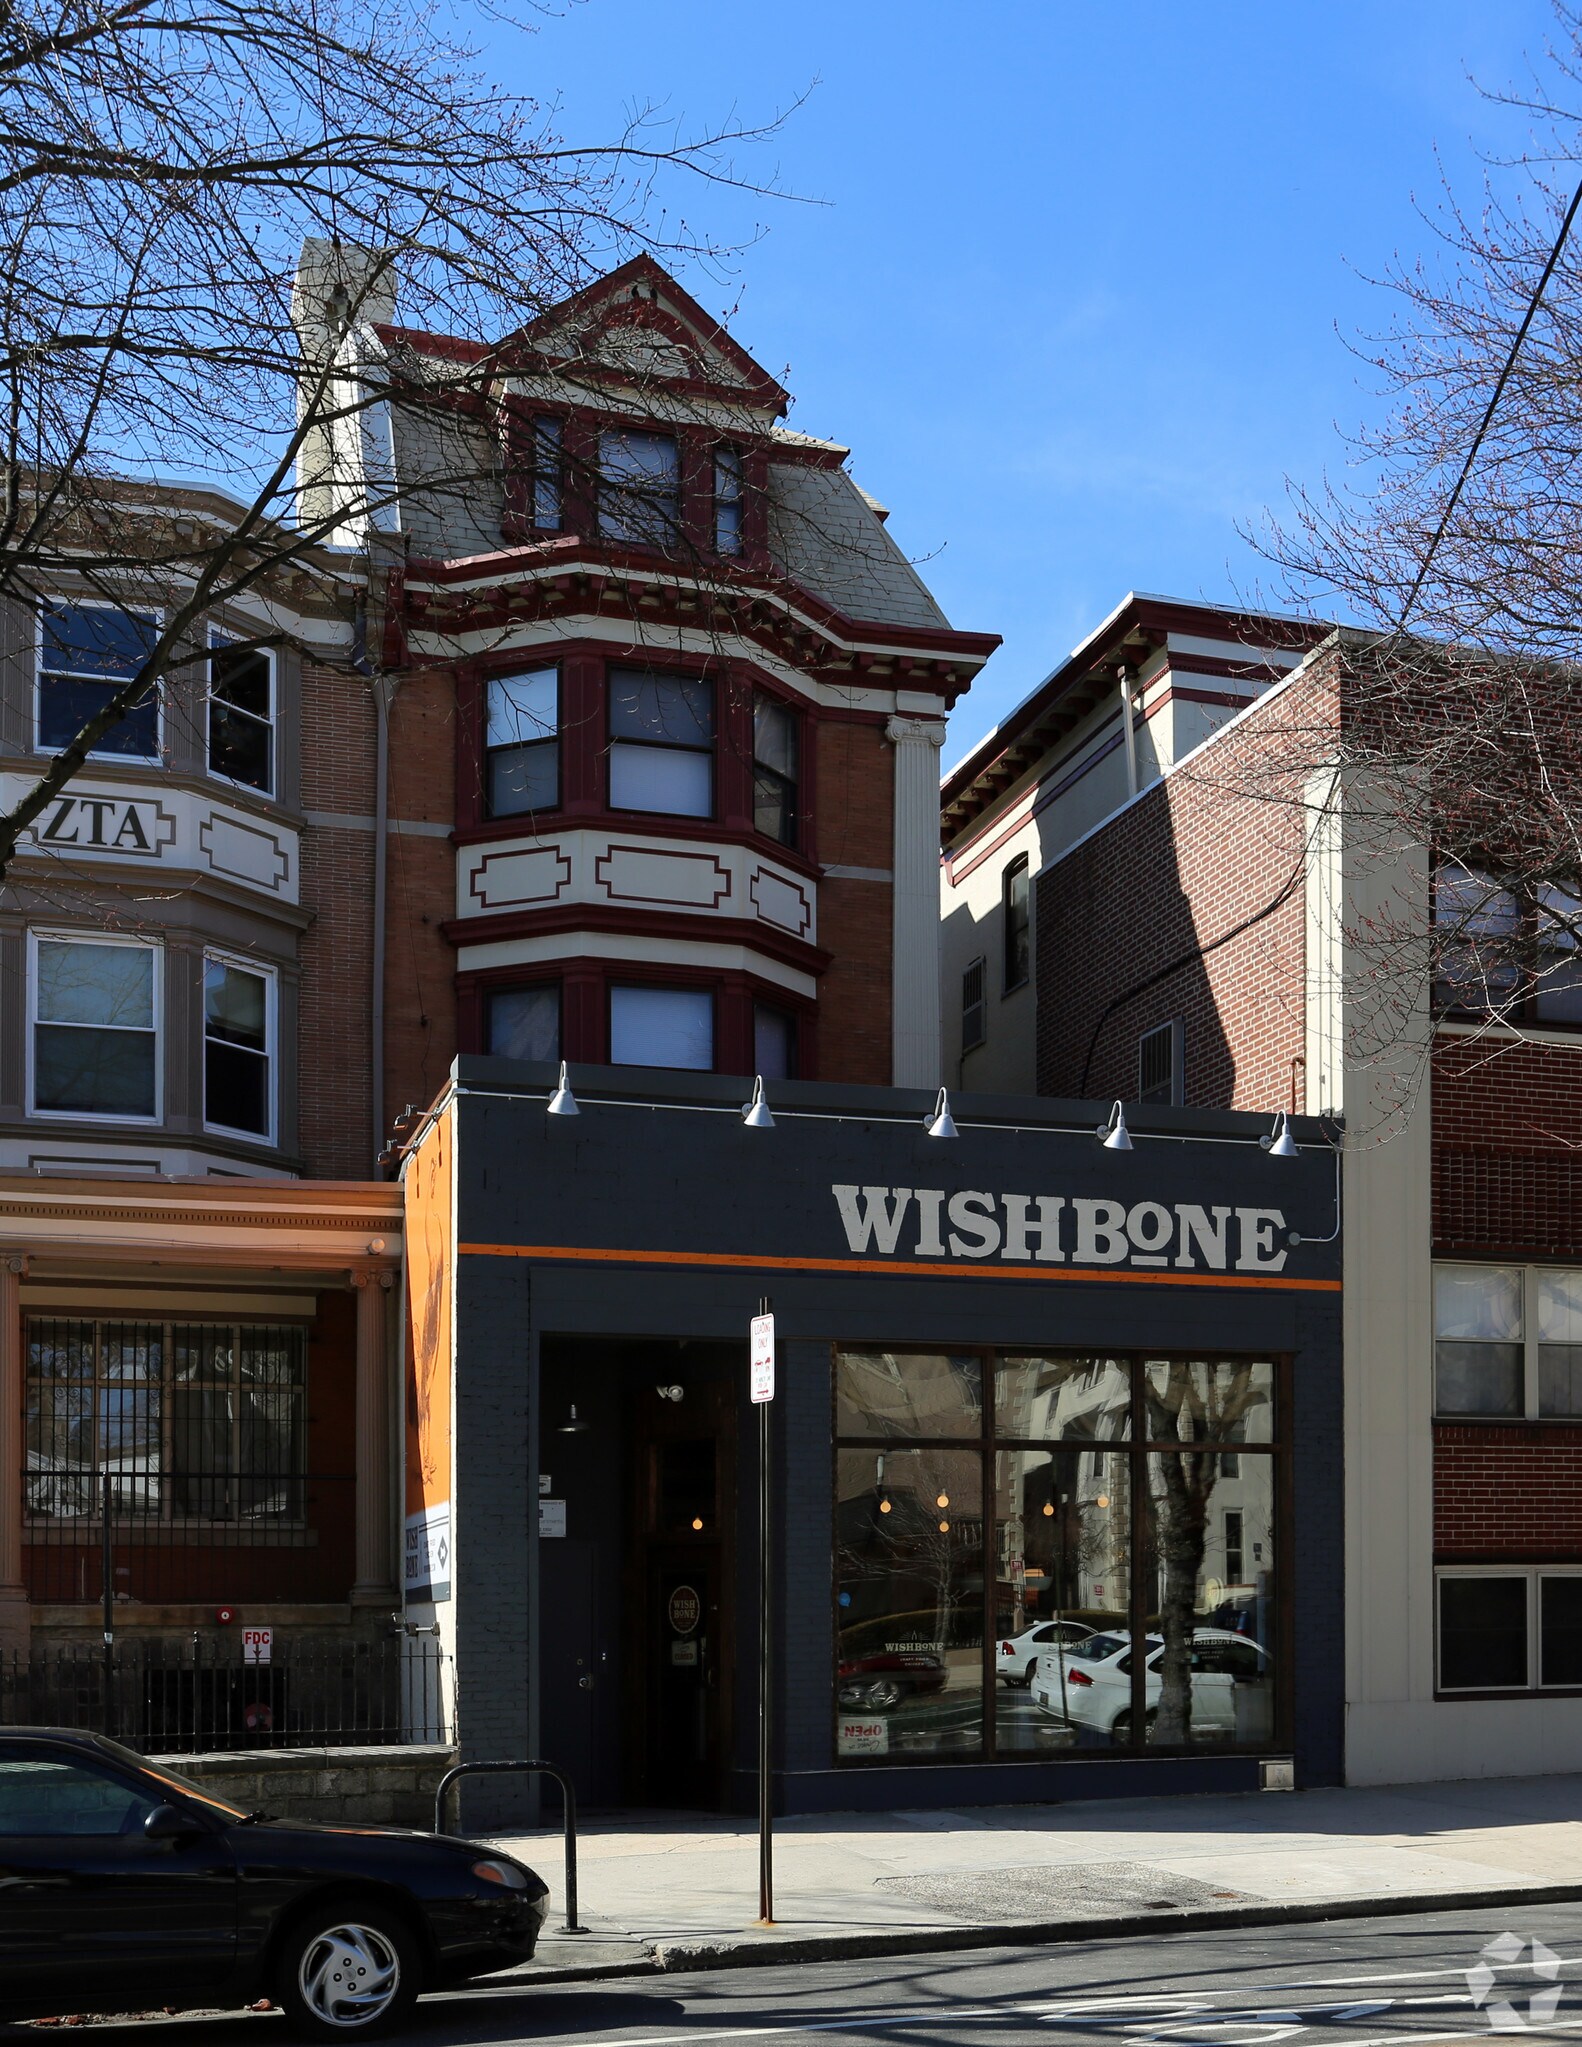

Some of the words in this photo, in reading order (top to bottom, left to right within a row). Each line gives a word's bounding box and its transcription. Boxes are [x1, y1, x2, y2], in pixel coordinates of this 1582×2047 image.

[42, 797, 151, 850] ZTA
[831, 1184, 1289, 1272] WISHBONE
[673, 1599, 696, 1609] WISH
[673, 1609, 696, 1619] BONE
[244, 1632, 270, 1645] FDC
[884, 1642, 944, 1652] WISHBONE
[844, 1724, 882, 1738] OPEN
